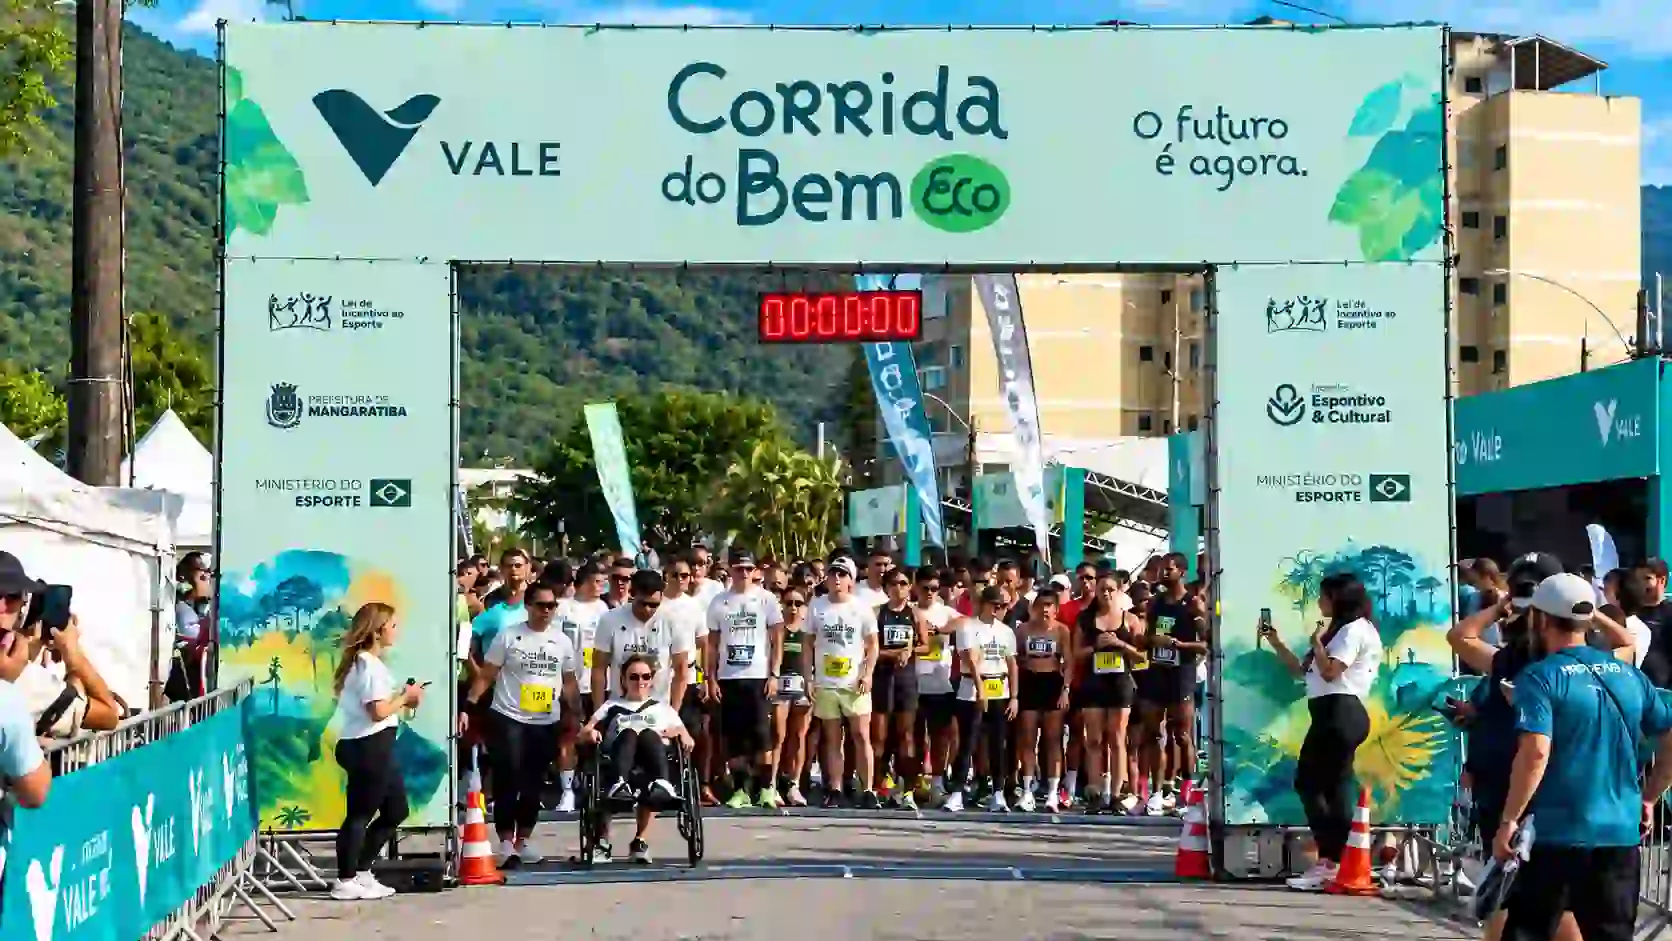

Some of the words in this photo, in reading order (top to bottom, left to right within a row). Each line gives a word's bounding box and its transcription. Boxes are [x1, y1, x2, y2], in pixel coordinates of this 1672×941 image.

[1133, 110, 1163, 140] O
[1177, 105, 1289, 145] futuro
[440, 140, 561, 176] VALE
[1155, 143, 1175, 176] é
[1189, 153, 1309, 192] agora.
[661, 154, 726, 206] do
[736, 148, 903, 226] Bem
[342, 319, 383, 331] Esporte
[308, 406, 408, 417] MANGARATIBA
[1311, 410, 1325, 424] &
[1328, 409, 1392, 424] Cultural
[340, 479, 362, 491] DO
[1340, 474, 1362, 486] DO
[295, 495, 361, 507] ESPORTE
[1296, 491, 1361, 502] ESPORTE
